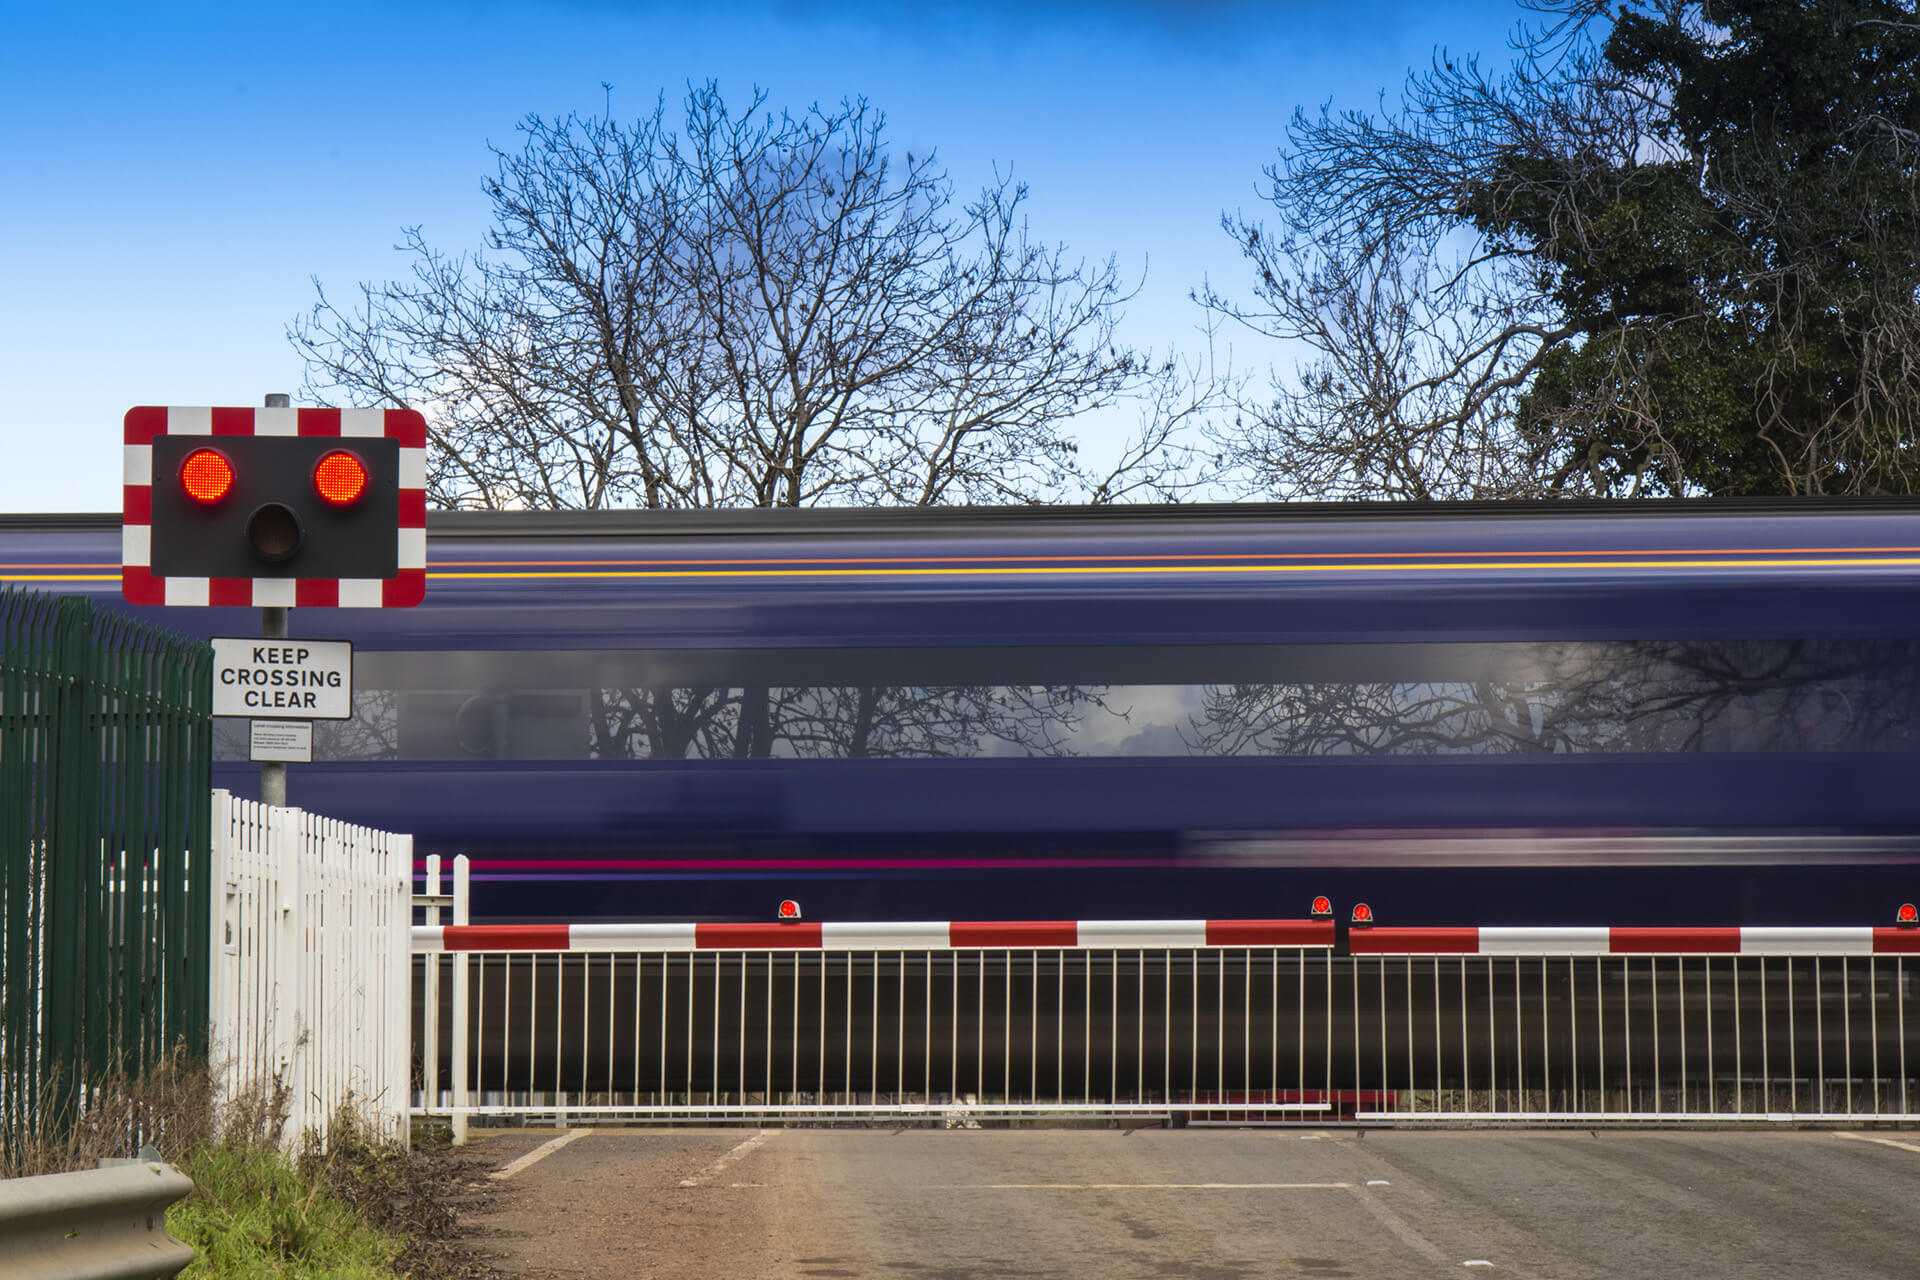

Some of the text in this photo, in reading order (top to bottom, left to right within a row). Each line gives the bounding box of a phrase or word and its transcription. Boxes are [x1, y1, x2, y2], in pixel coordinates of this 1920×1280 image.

[253, 647, 309, 664] KEEP
[220, 668, 341, 687] CROSSING
[244, 690, 316, 708] CLEAR
